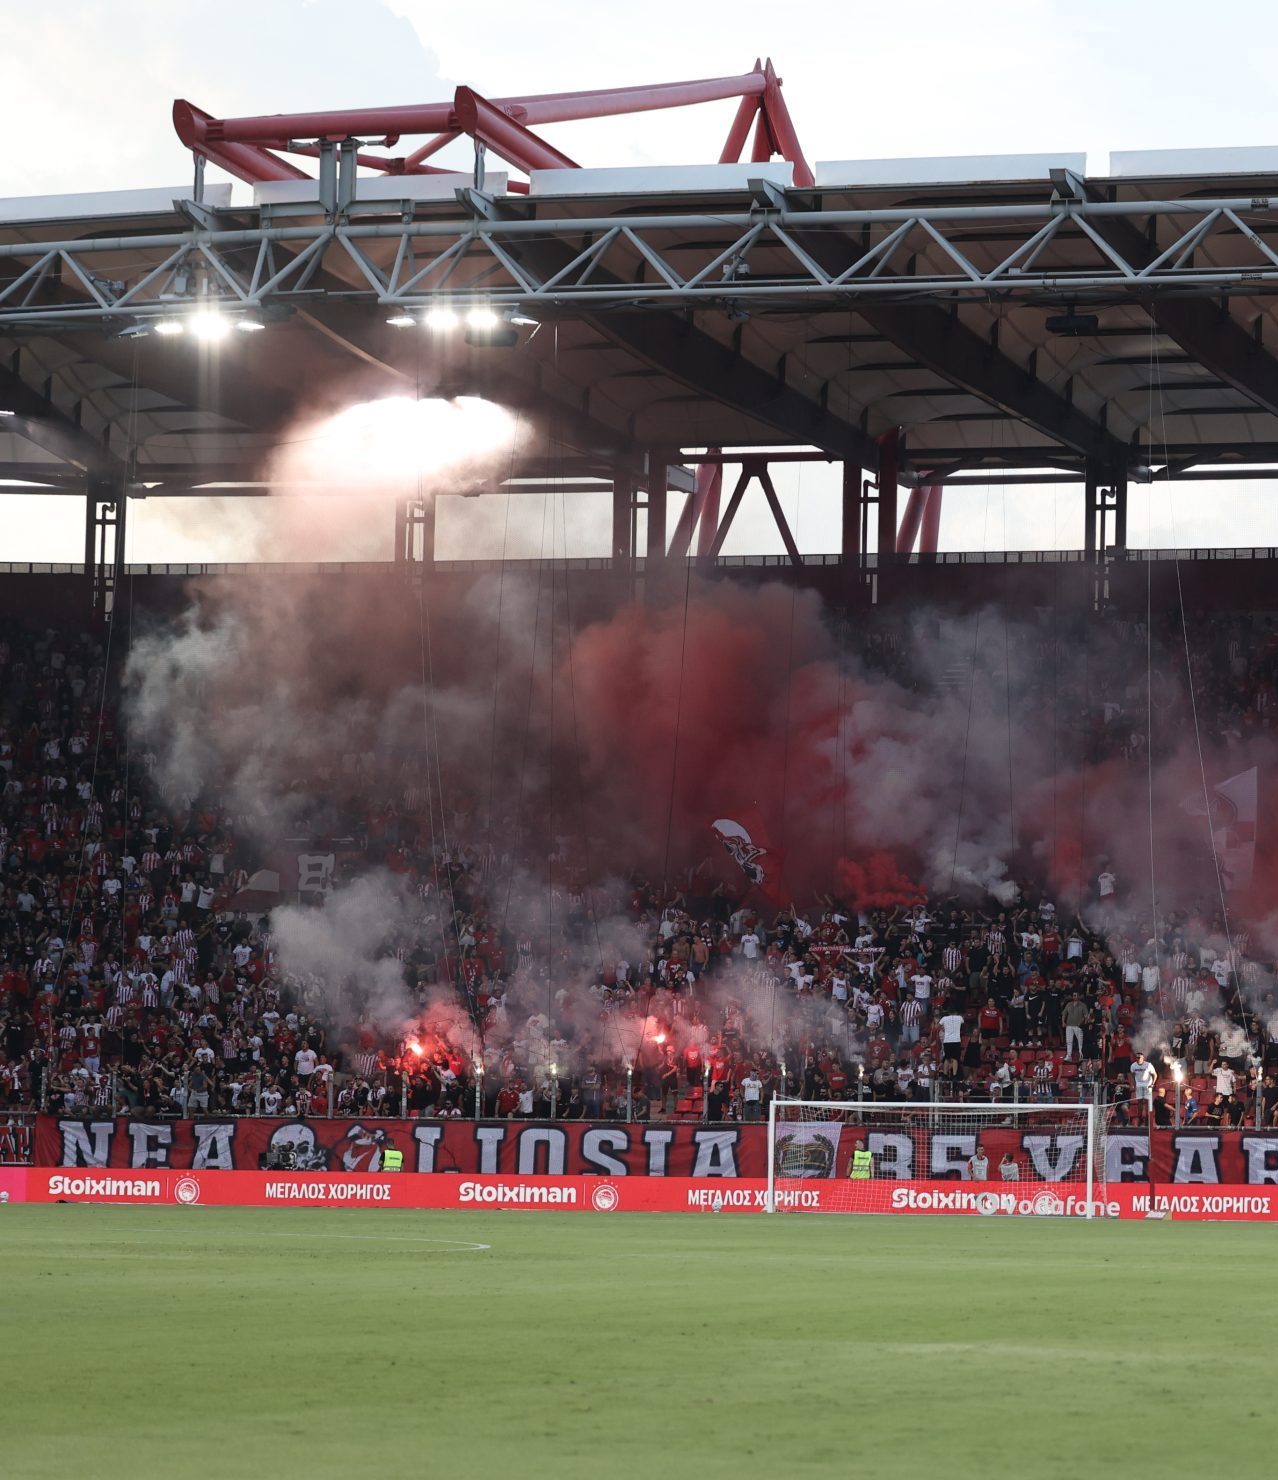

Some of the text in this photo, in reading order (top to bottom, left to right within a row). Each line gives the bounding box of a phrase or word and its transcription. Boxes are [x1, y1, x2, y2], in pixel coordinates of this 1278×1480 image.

[58, 1120, 235, 1169] NEA
[49, 1176, 160, 1197] Stoiximan
[265, 1182, 391, 1200] ΜΕΓΑΛΟΣ ΧΟΡΗΓΟΣ
[458, 1182, 577, 1203] Stoiximan
[687, 1189, 752, 1206] ΜΕΓΑΛΟΣ
[1201, 1196, 1271, 1214] ΧΟΡΗΓΟΣ
